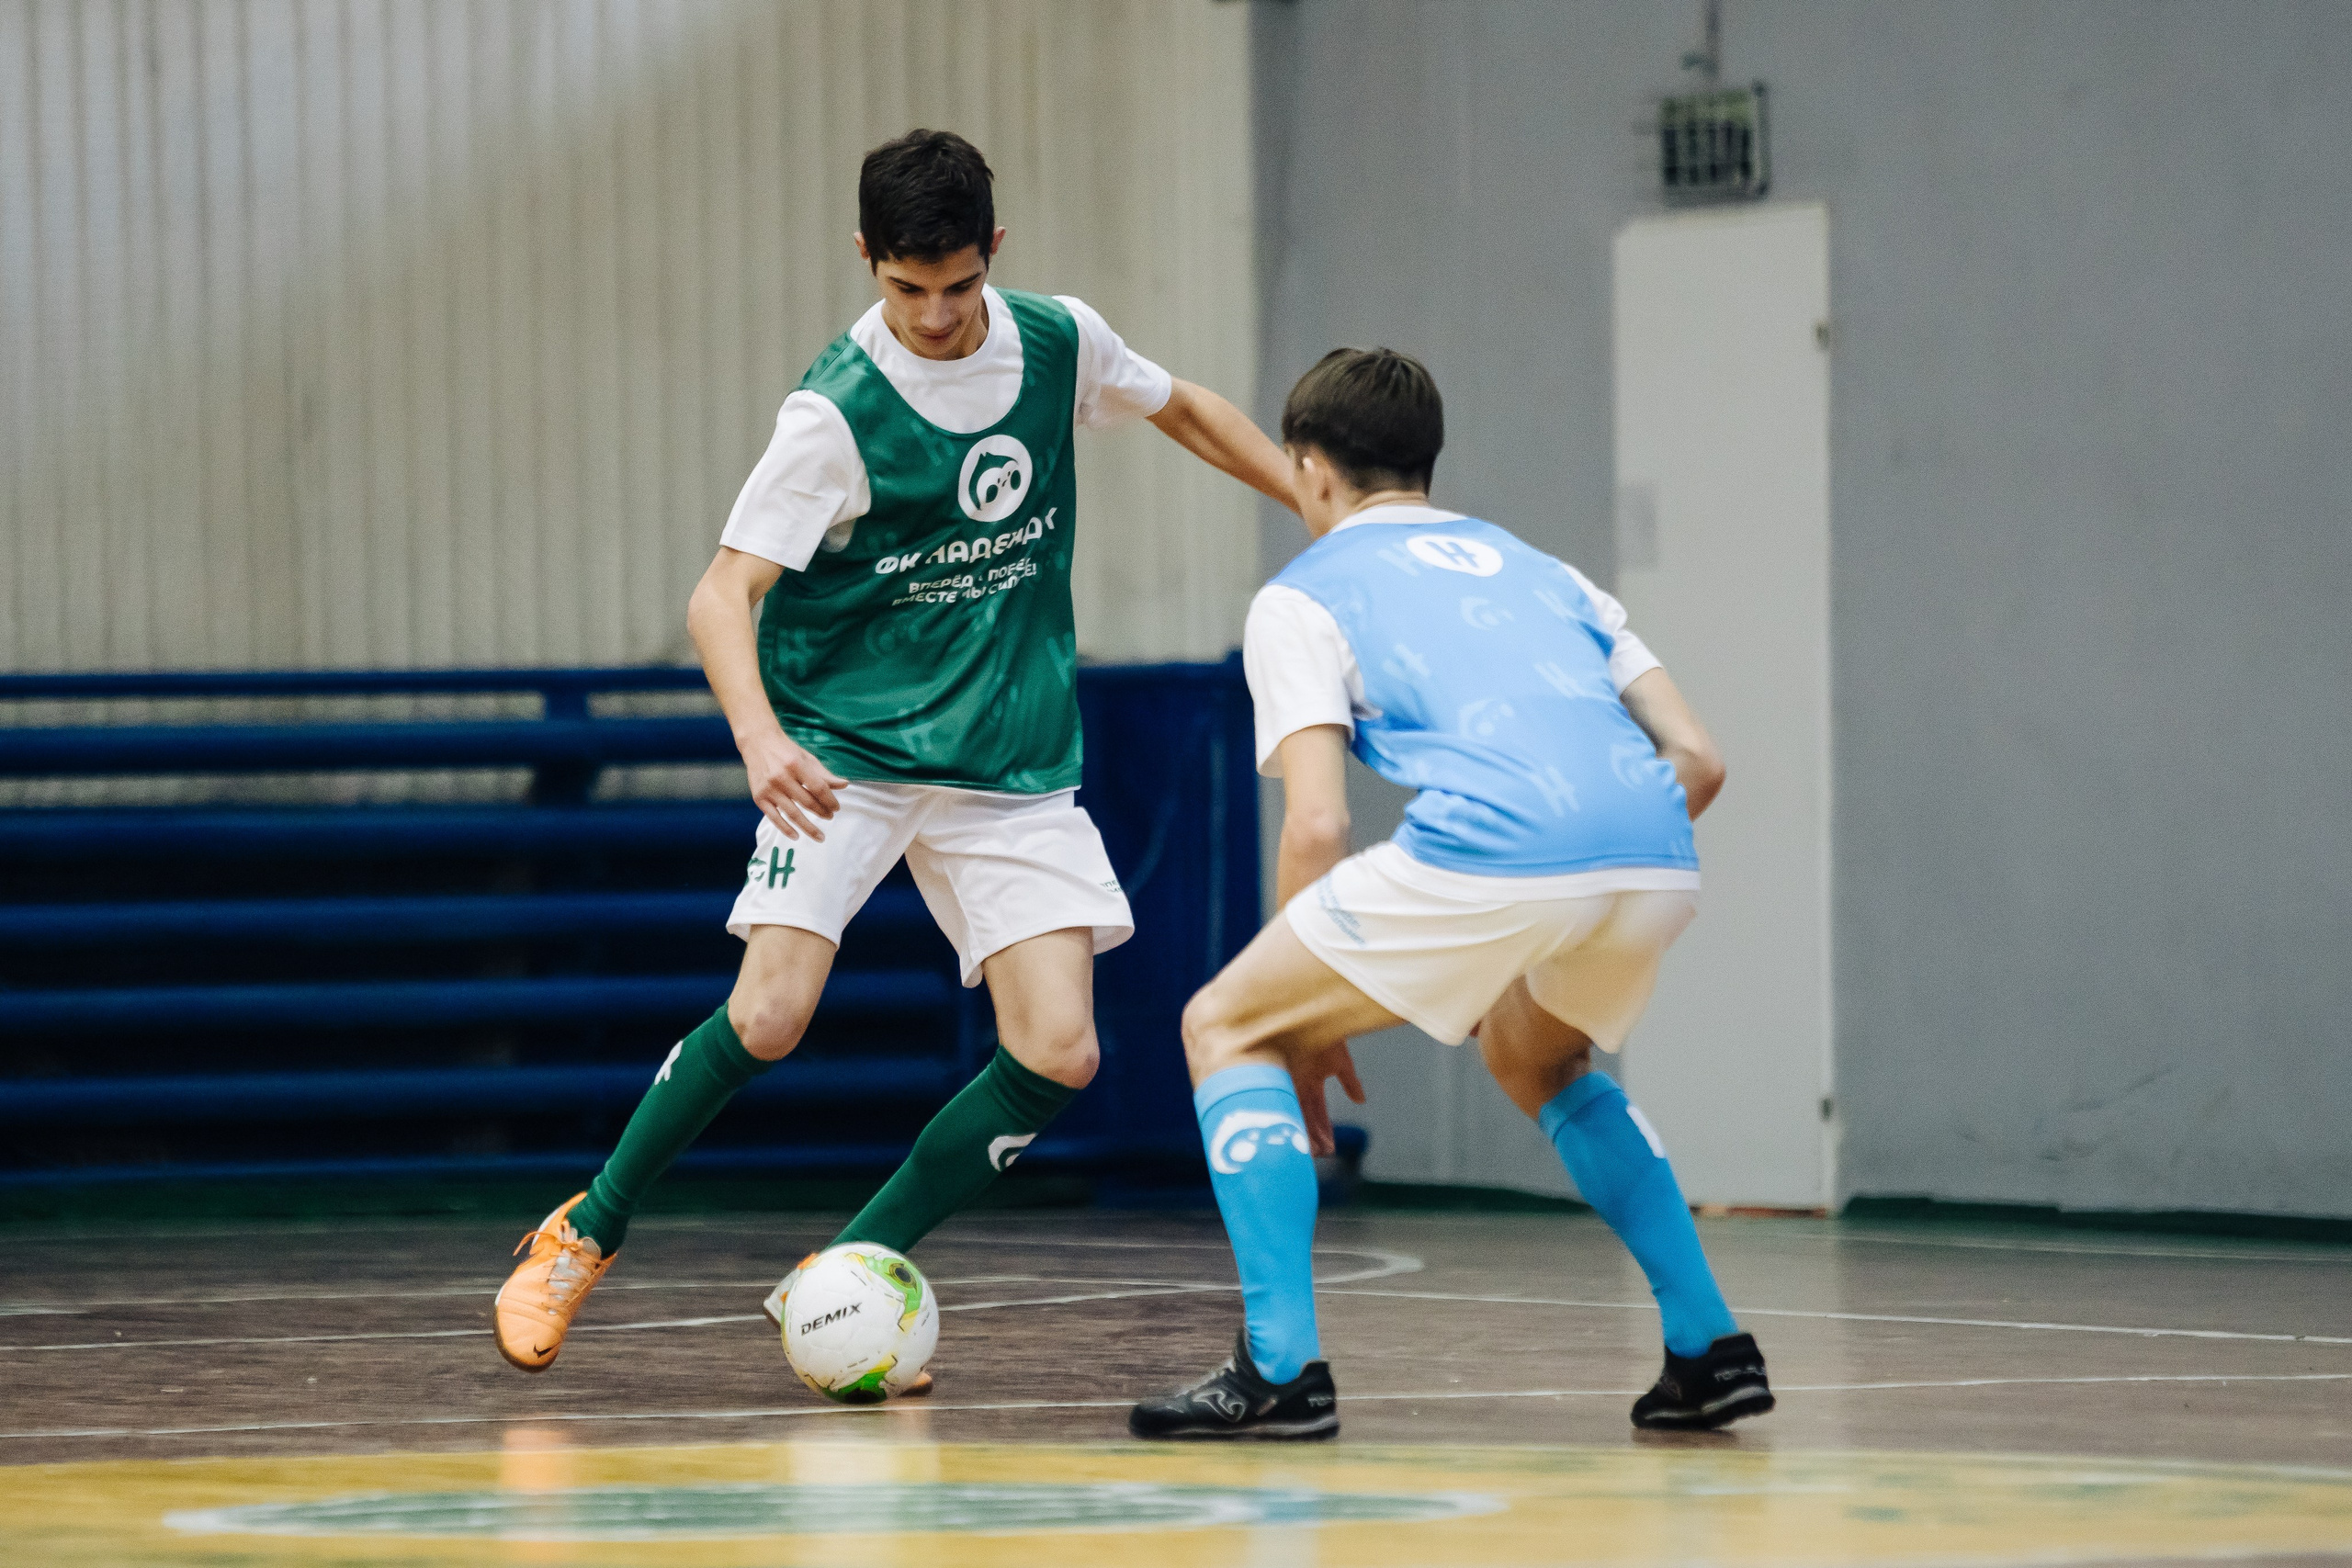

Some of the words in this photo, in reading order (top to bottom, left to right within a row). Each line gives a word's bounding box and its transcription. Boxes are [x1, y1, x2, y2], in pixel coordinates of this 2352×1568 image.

[875, 552, 922, 574] ФК
[909, 574, 974, 593] ВПЕРЁД
[801, 1303, 863, 1337] DEMIX
